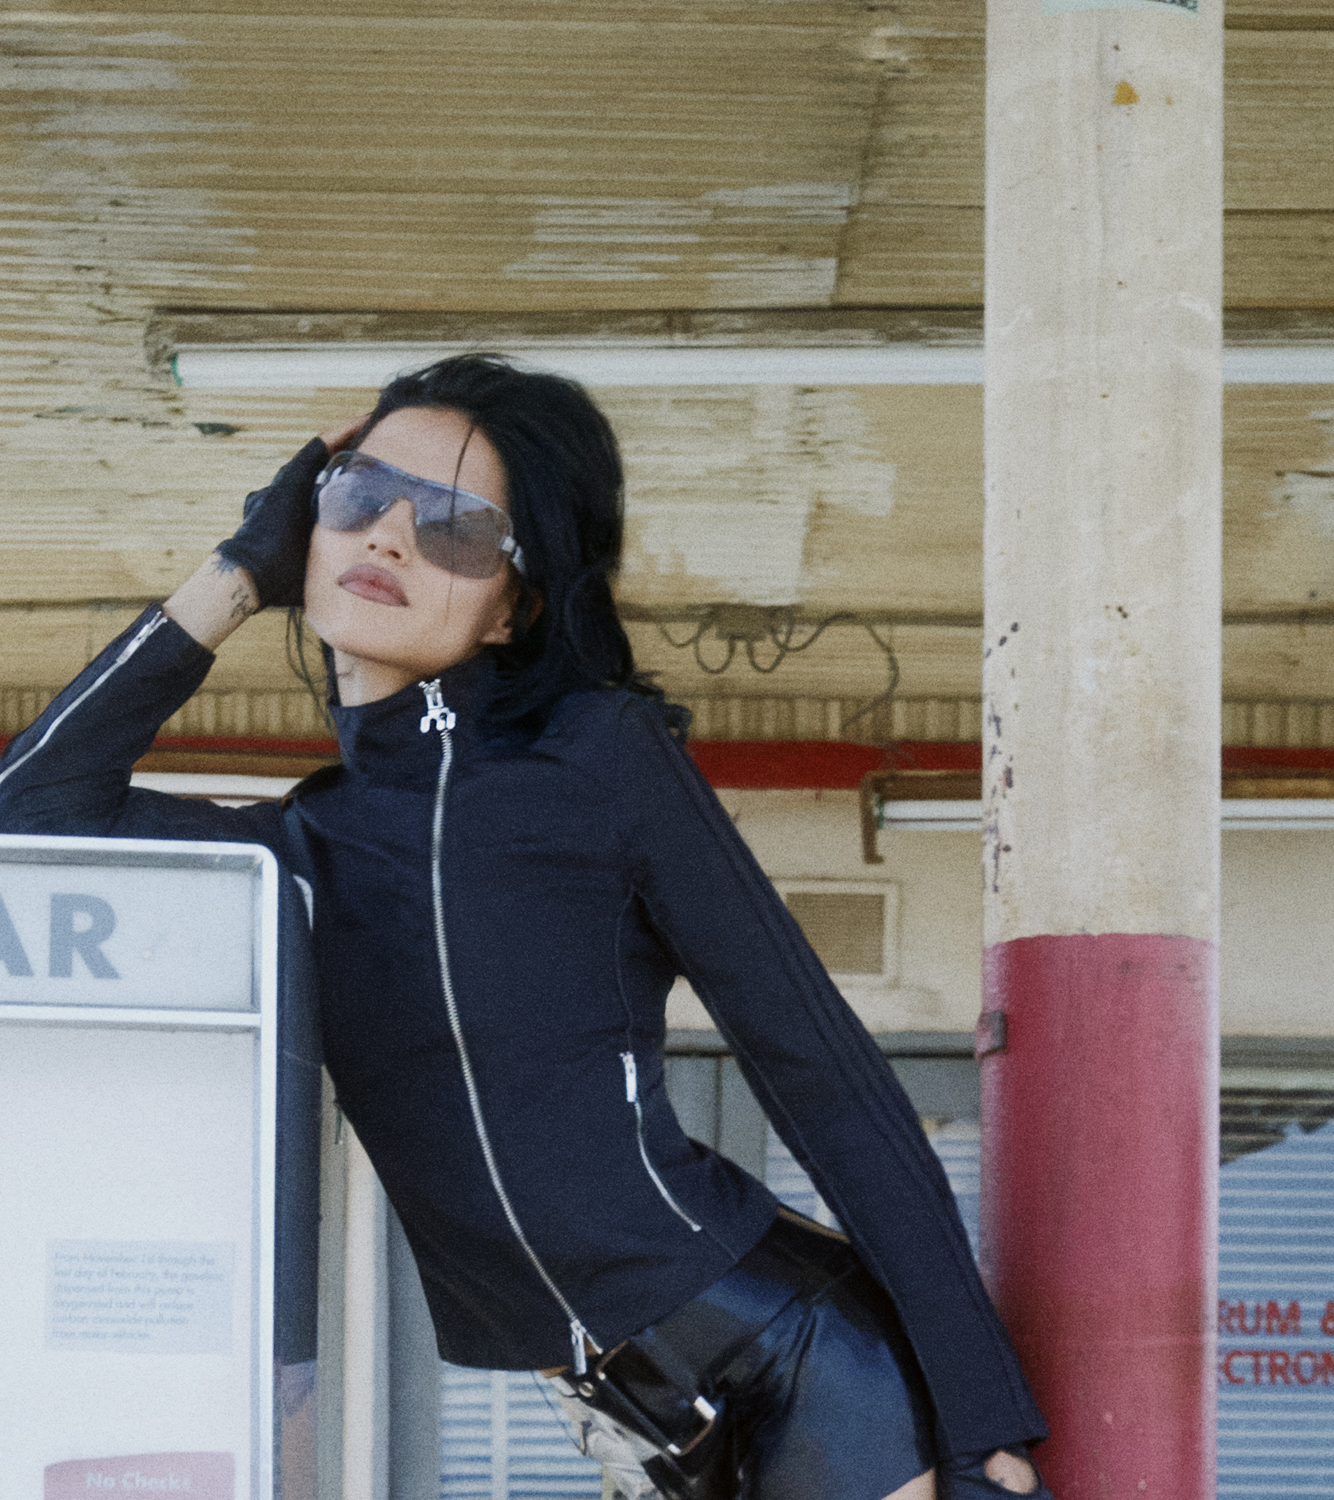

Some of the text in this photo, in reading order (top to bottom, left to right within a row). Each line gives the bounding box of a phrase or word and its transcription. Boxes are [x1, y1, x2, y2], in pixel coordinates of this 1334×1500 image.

[1218, 1300, 1301, 1336] RUM
[85, 1471, 192, 1492] No Checks
